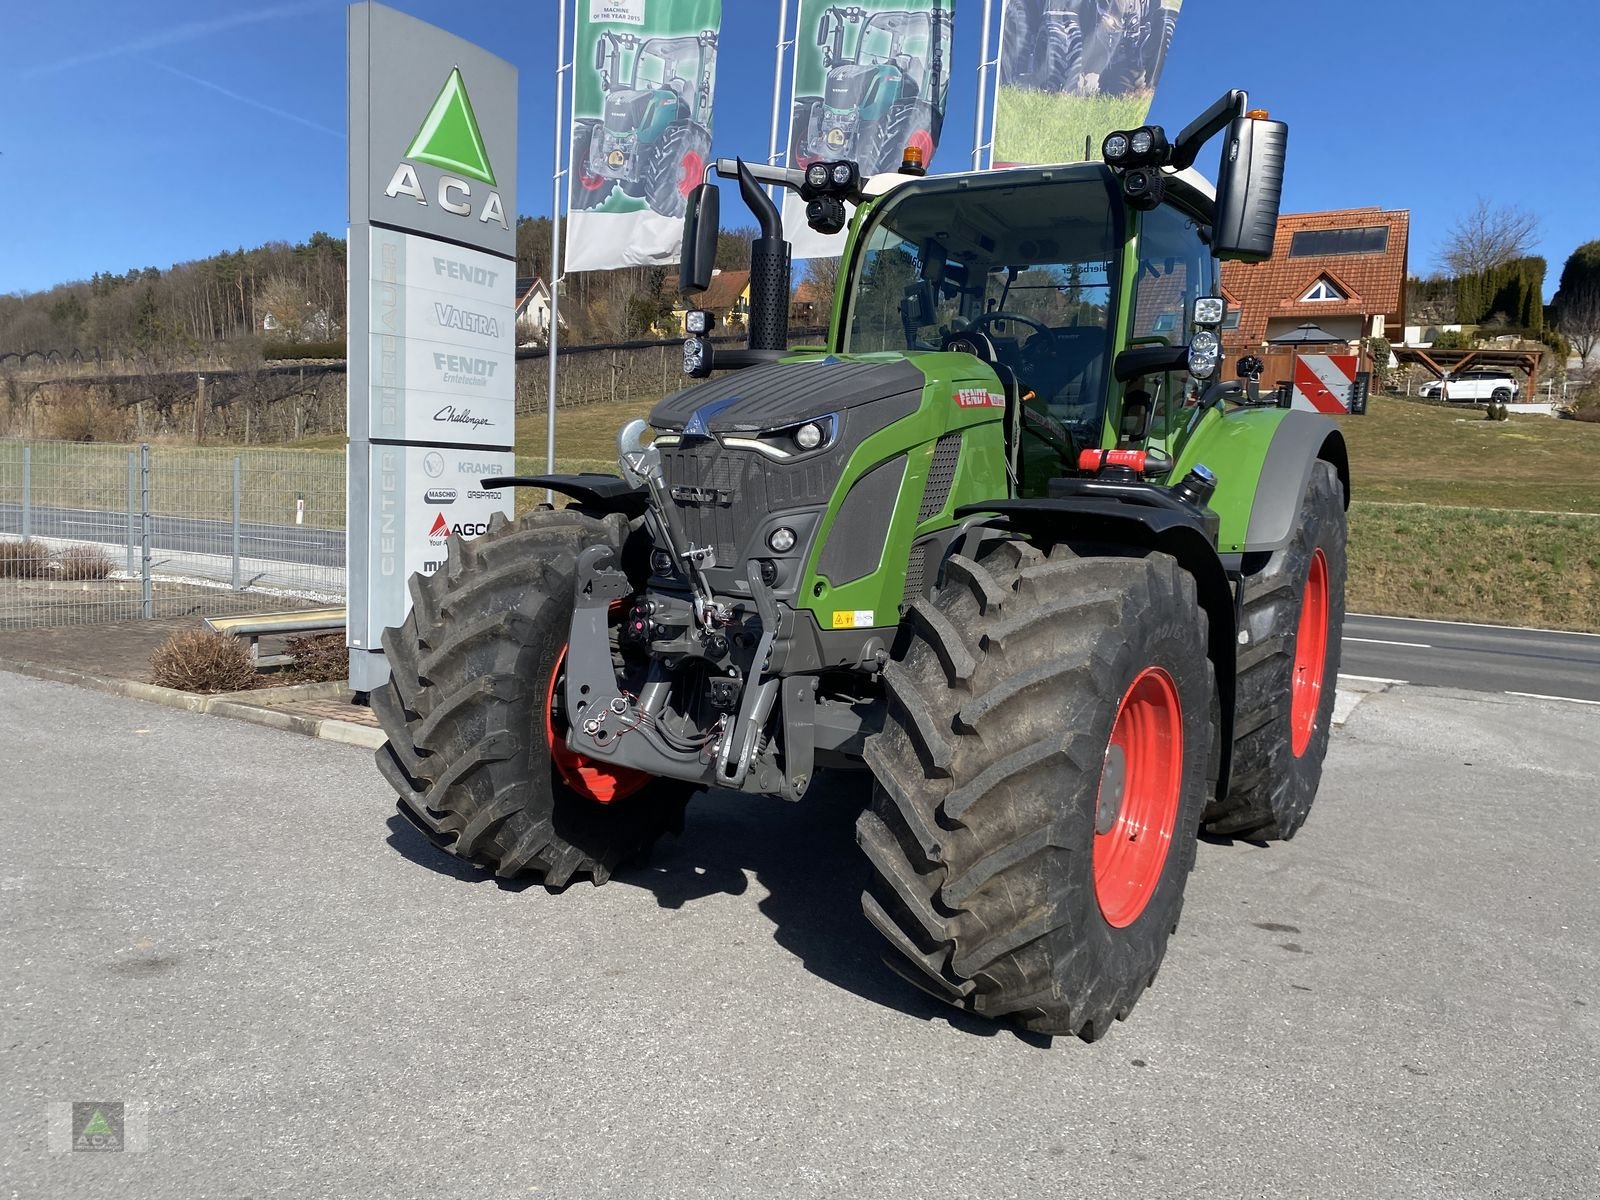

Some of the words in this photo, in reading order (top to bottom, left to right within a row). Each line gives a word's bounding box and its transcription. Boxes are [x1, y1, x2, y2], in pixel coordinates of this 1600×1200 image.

[383, 162, 509, 231] ACA
[432, 257, 499, 289] FENDT
[433, 302, 499, 338] VALTRA
[381, 243, 398, 426] BIERBAUER
[432, 351, 498, 378] FENDT
[958, 388, 987, 406] FENDT
[433, 404, 496, 431] Challenger
[458, 462, 504, 475] KRAMER
[428, 490, 457, 499] MASCHIO
[467, 490, 502, 500] GASPARDO
[381, 452, 396, 577] CENTER
[429, 539, 443, 547] Your
